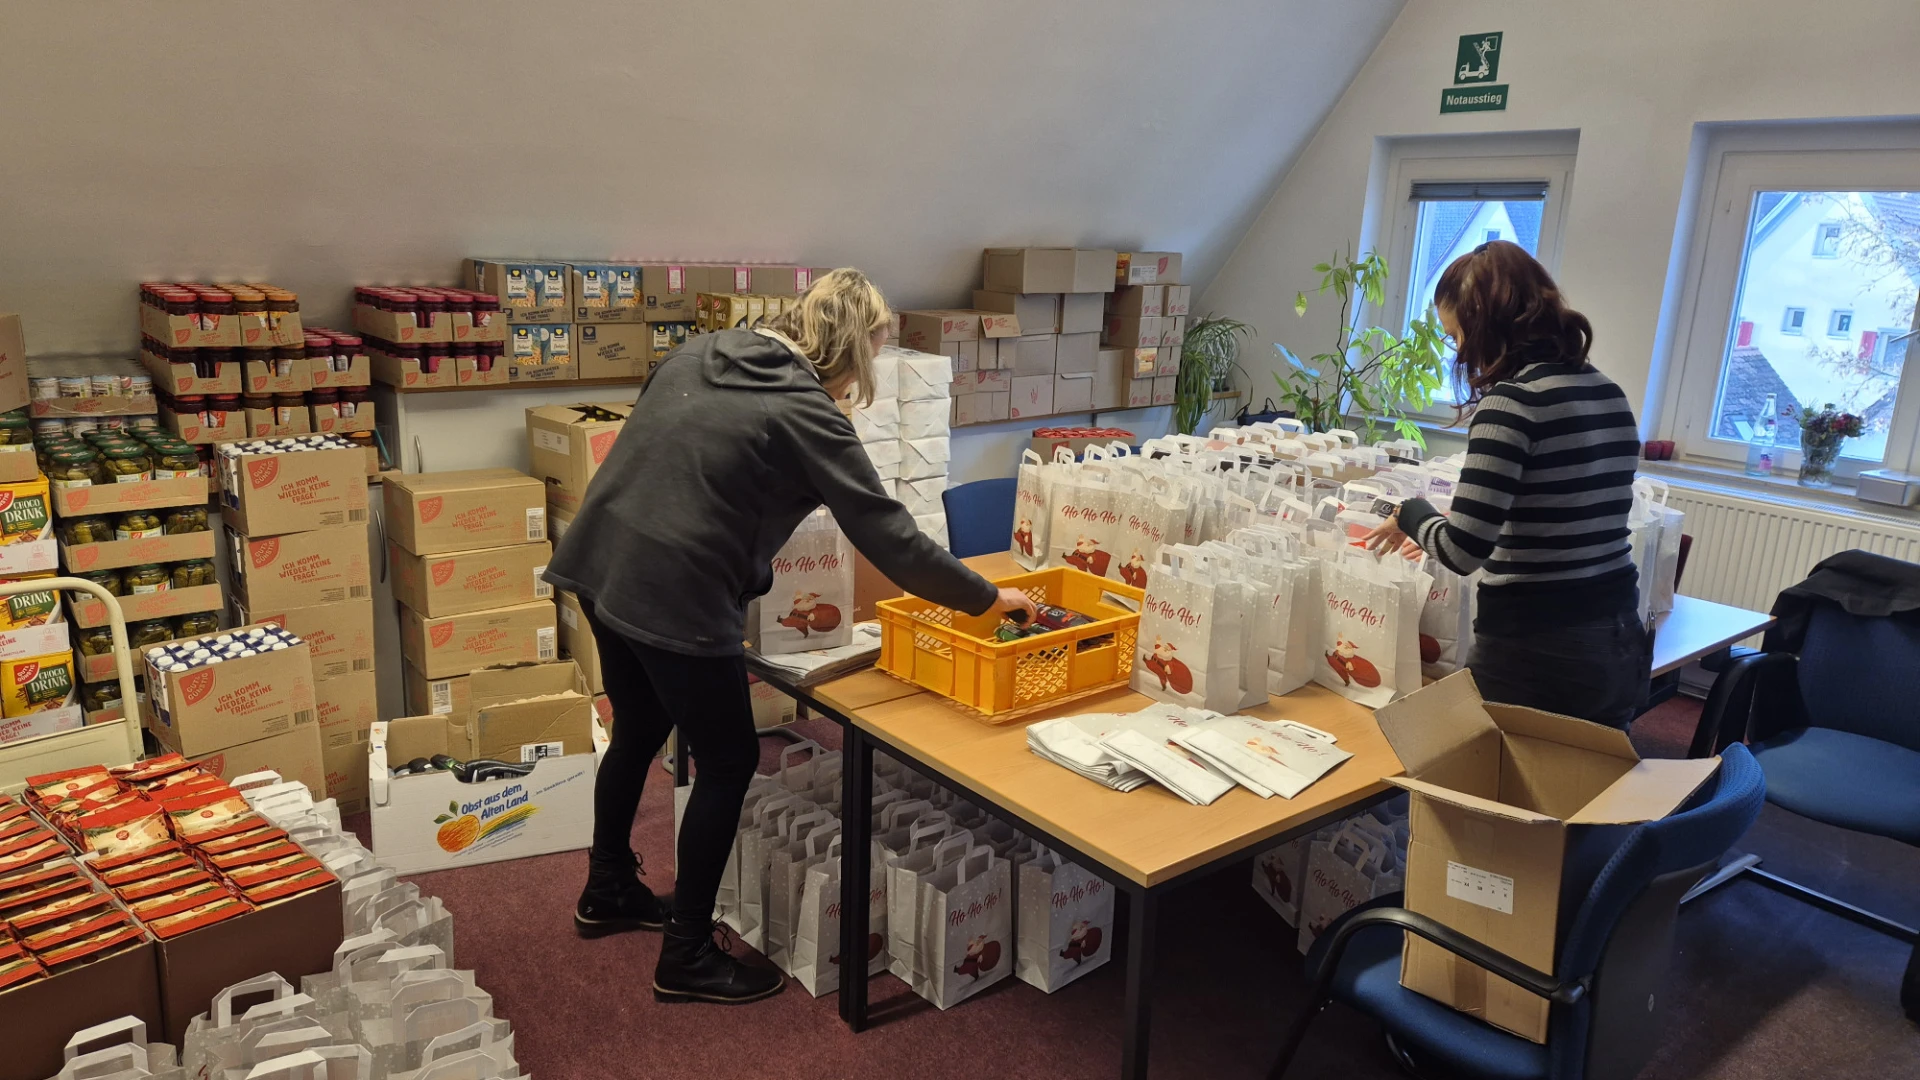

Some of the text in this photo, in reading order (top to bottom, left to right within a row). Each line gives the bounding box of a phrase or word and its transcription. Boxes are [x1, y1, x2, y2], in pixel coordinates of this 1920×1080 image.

[1446, 92, 1502, 106] Notausstieg
[280, 475, 319, 492] ICH KOMM
[309, 480, 331, 492] KEINE
[13, 498, 40, 510] CHOCO
[291, 492, 317, 503] FRAGE!
[4, 506, 44, 523] DRINK
[1061, 505, 1079, 520] Ho
[1080, 507, 1098, 523] Ho
[1128, 515, 1141, 531] Ho
[1141, 520, 1150, 536] Ho
[282, 554, 320, 571] ICH KOMM
[310, 558, 332, 570] KEINE
[772, 552, 845, 576] Ho Ho Ho!
[292, 570, 318, 582] FRAGE!
[12, 591, 52, 610] DRINK
[1145, 594, 1157, 613] Ho
[1158, 600, 1176, 620] Ho
[1326, 591, 1339, 610] Ho
[1339, 599, 1357, 619] Ho
[315, 634, 336, 645] KEINE
[38, 667, 65, 680] CHOCO
[30, 674, 68, 693] DRINK
[249, 684, 273, 700] KEINE
[217, 681, 260, 704] ICH KOMM
[230, 699, 258, 715] FRAGE!
[320, 704, 341, 717] KEINE
[12, 721, 32, 732] KEINE
[461, 783, 522, 815] Obst aus dem
[480, 790, 529, 820] Alten Land
[1313, 869, 1327, 887] Ho
[1328, 879, 1341, 898] Ho
[1052, 892, 1068, 909] Ho
[1069, 885, 1085, 903] Ho
[948, 909, 966, 927] Ho
[967, 901, 983, 919] Ho
